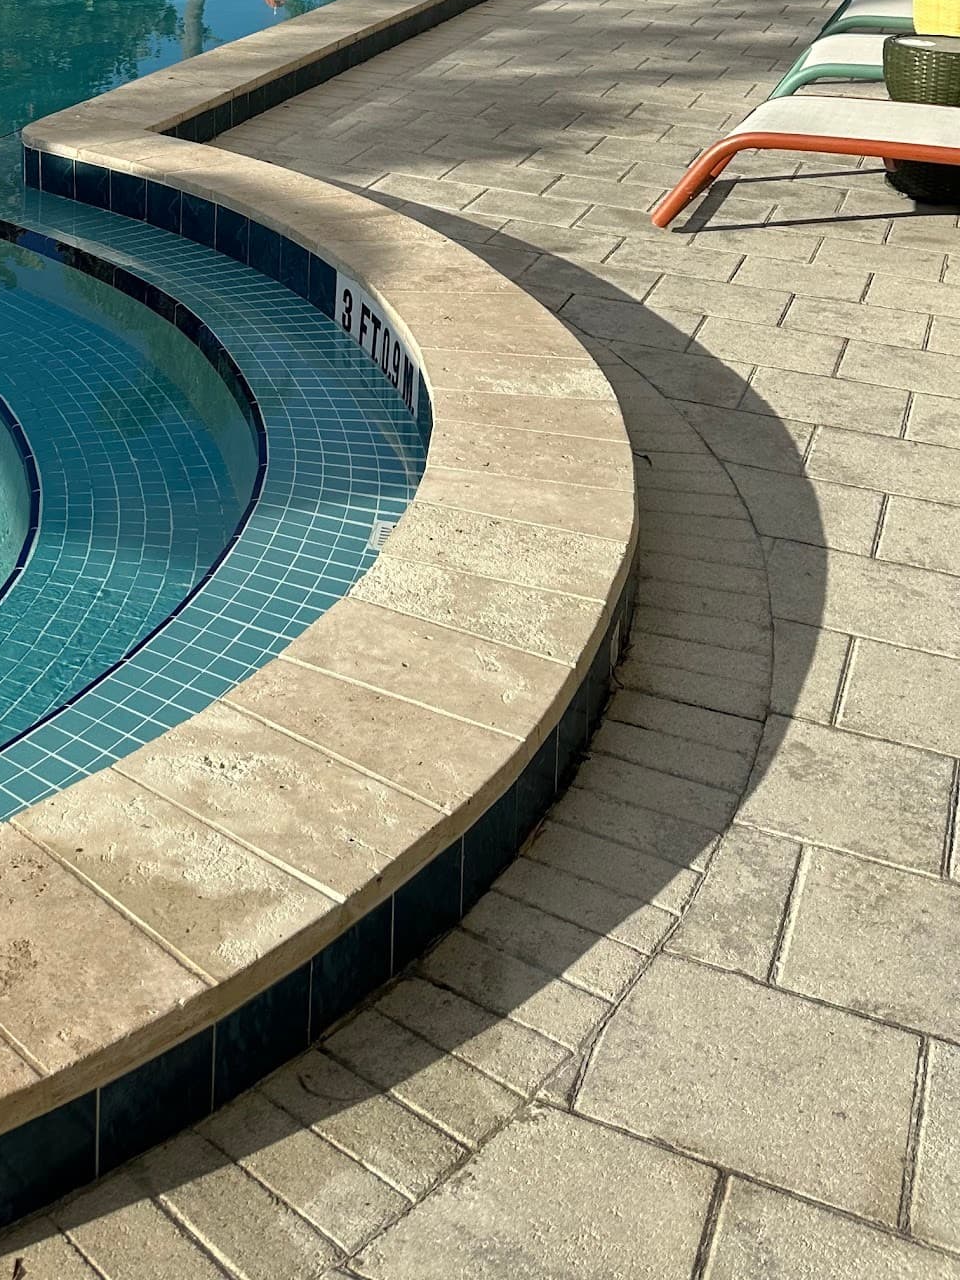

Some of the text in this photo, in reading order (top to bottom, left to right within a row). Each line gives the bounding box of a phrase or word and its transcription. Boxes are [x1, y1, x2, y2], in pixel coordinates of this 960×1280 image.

[342, 288, 415, 416] 3 FT. 0.9 M.
